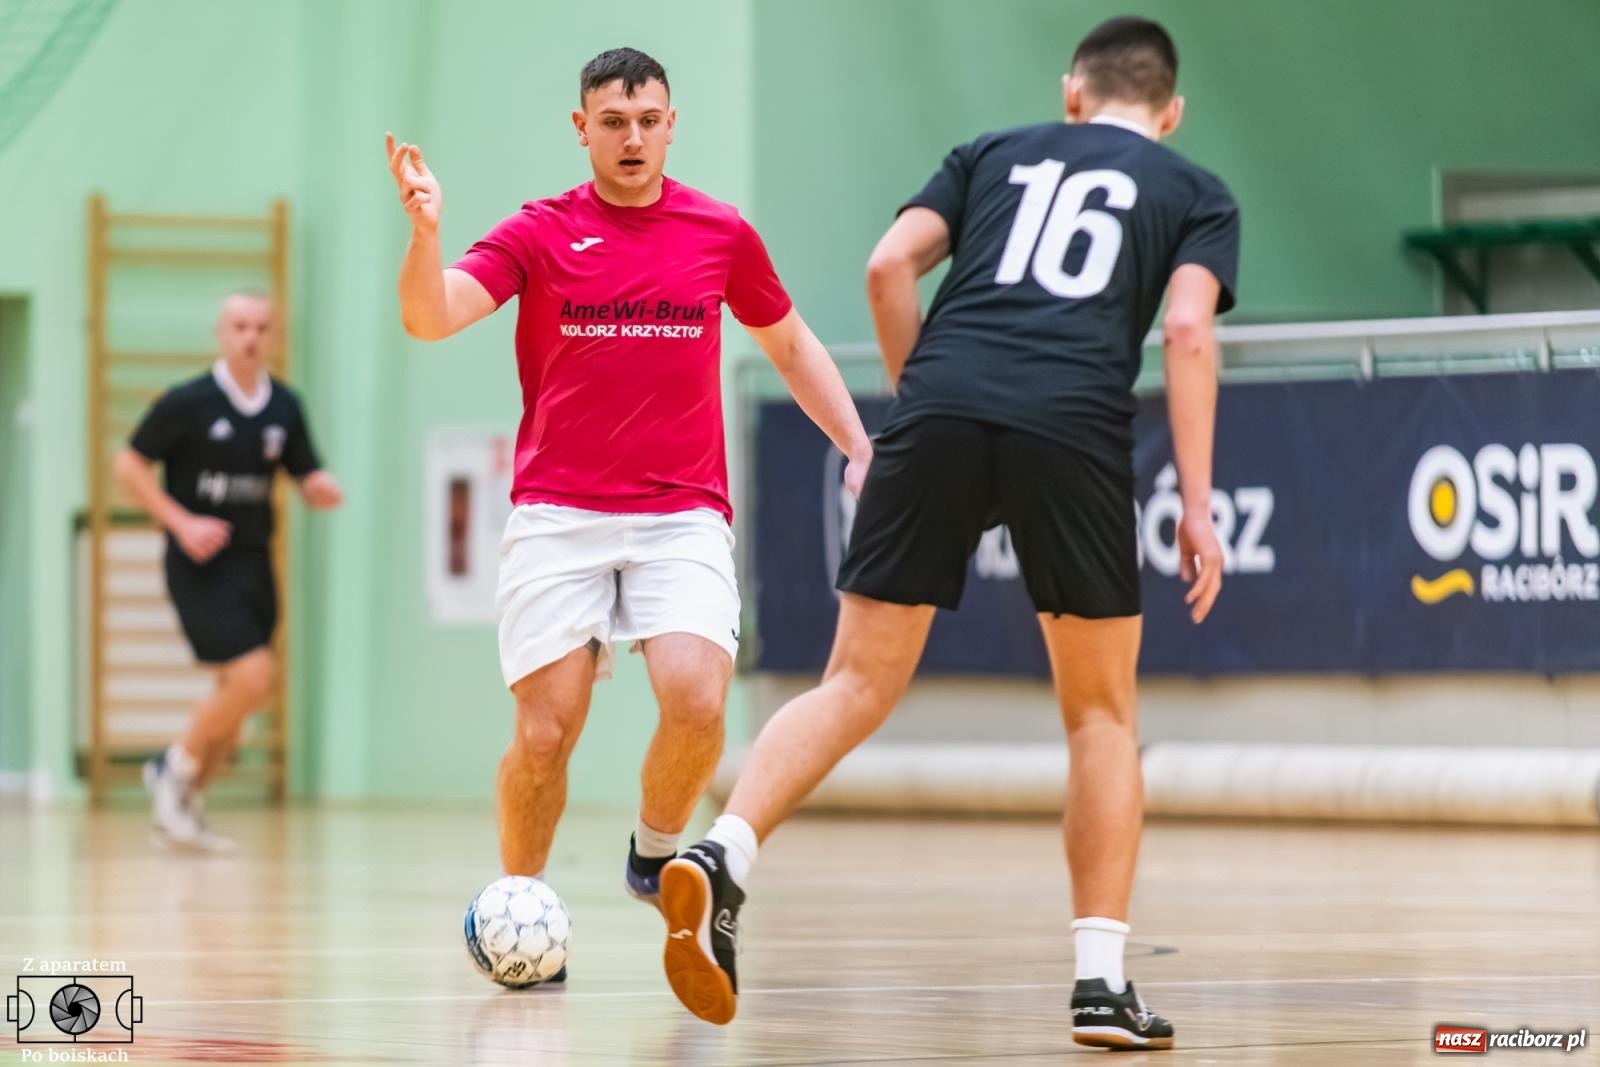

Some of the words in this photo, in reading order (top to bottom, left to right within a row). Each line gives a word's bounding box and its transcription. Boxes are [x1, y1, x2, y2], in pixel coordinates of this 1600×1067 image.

[994, 158, 1138, 299] 16
[560, 300, 706, 320] AmeWi-Bruk
[560, 324, 617, 337] KOLORZ
[621, 324, 704, 339] KRZYSZTOF
[1481, 554, 1600, 602] RACIBÓRZ
